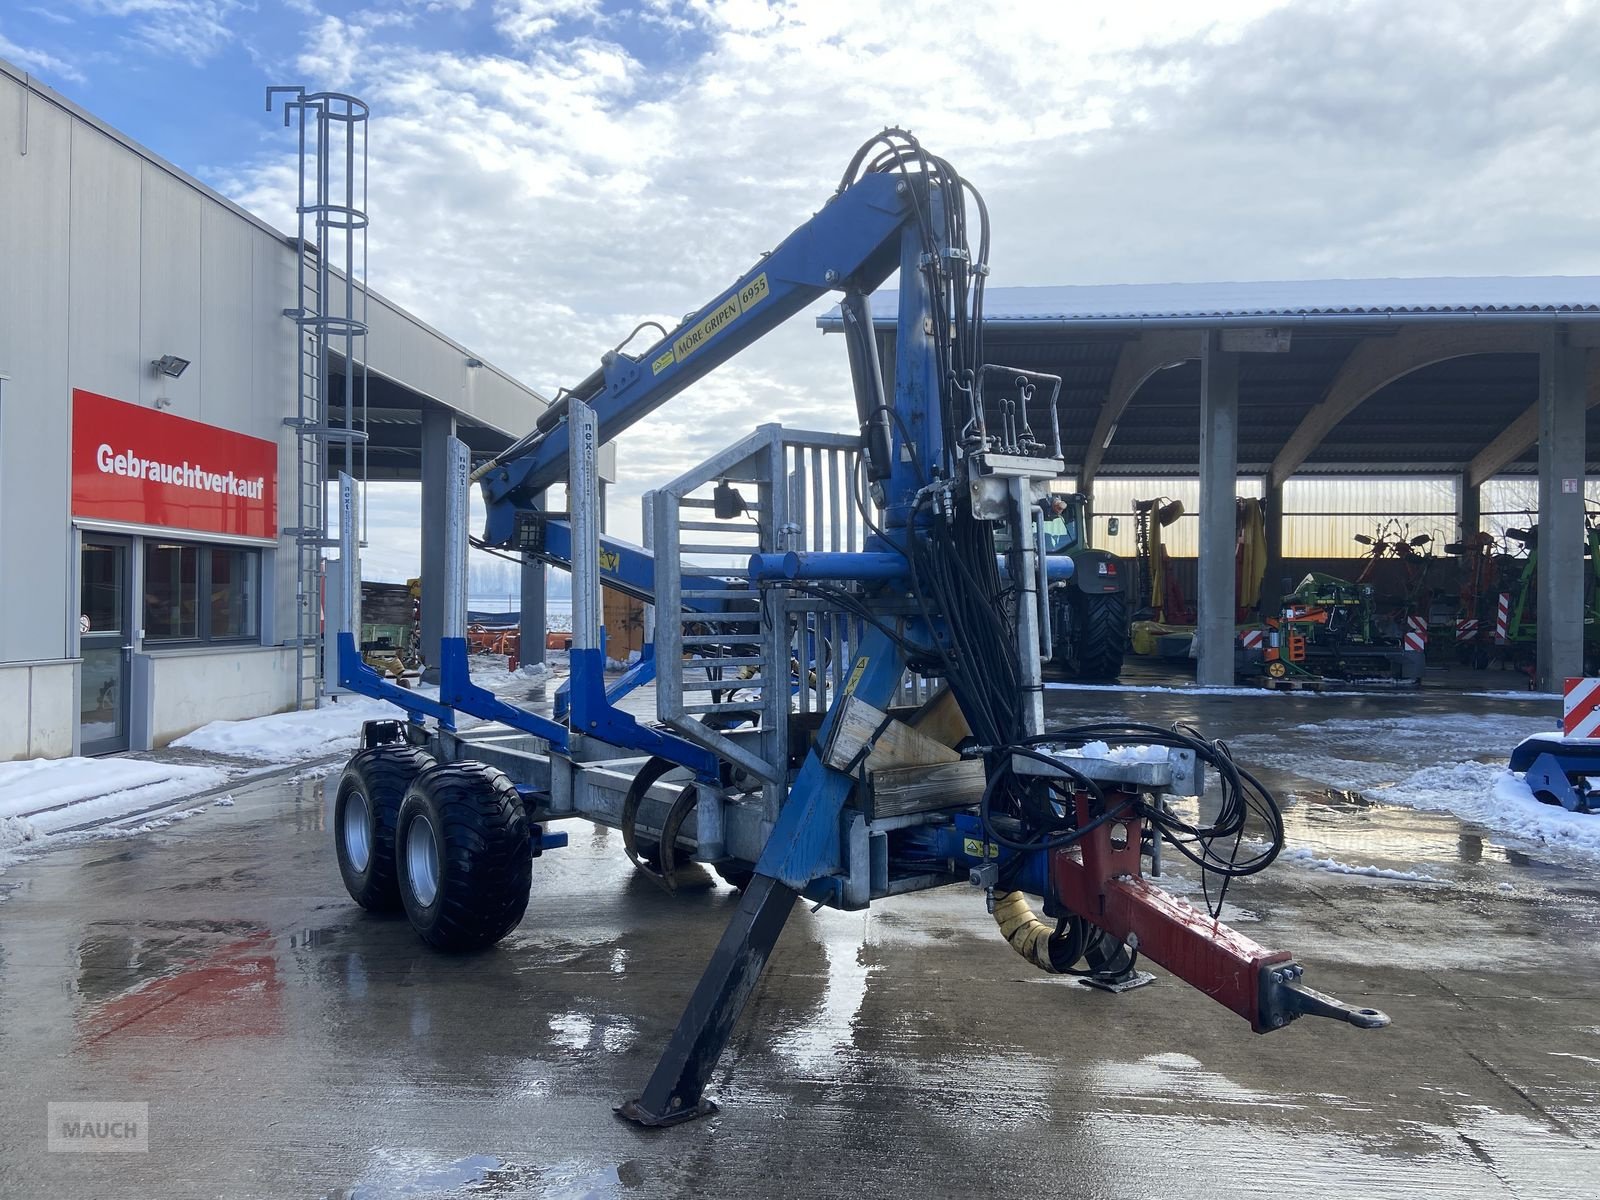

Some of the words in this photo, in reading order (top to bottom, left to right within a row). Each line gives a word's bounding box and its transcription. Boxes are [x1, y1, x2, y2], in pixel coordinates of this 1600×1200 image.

[742, 278, 766, 304] 6955
[704, 302, 737, 334] GRIPEN
[97, 443, 264, 500] Gebrauchtverkauf
